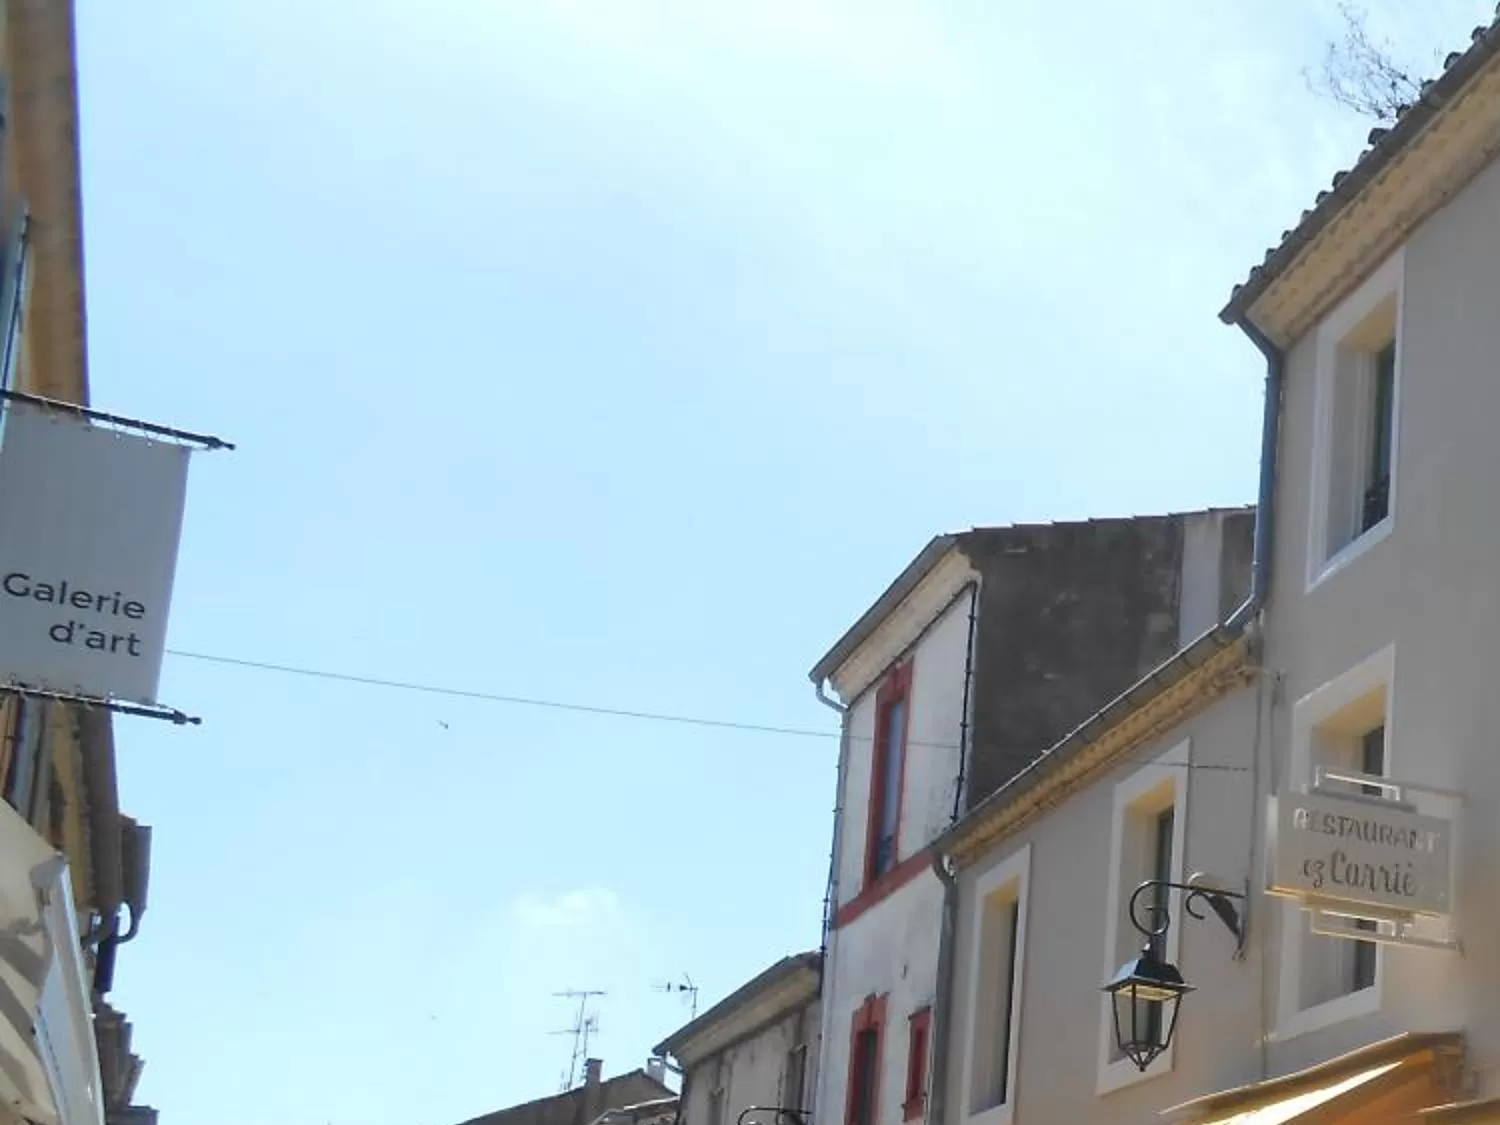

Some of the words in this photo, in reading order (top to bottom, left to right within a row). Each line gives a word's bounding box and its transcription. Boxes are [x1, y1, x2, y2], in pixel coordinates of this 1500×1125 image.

[2, 572, 146, 619] Galerie
[49, 620, 142, 657] d'art
[1293, 806, 1441, 853] RESTAURANT
